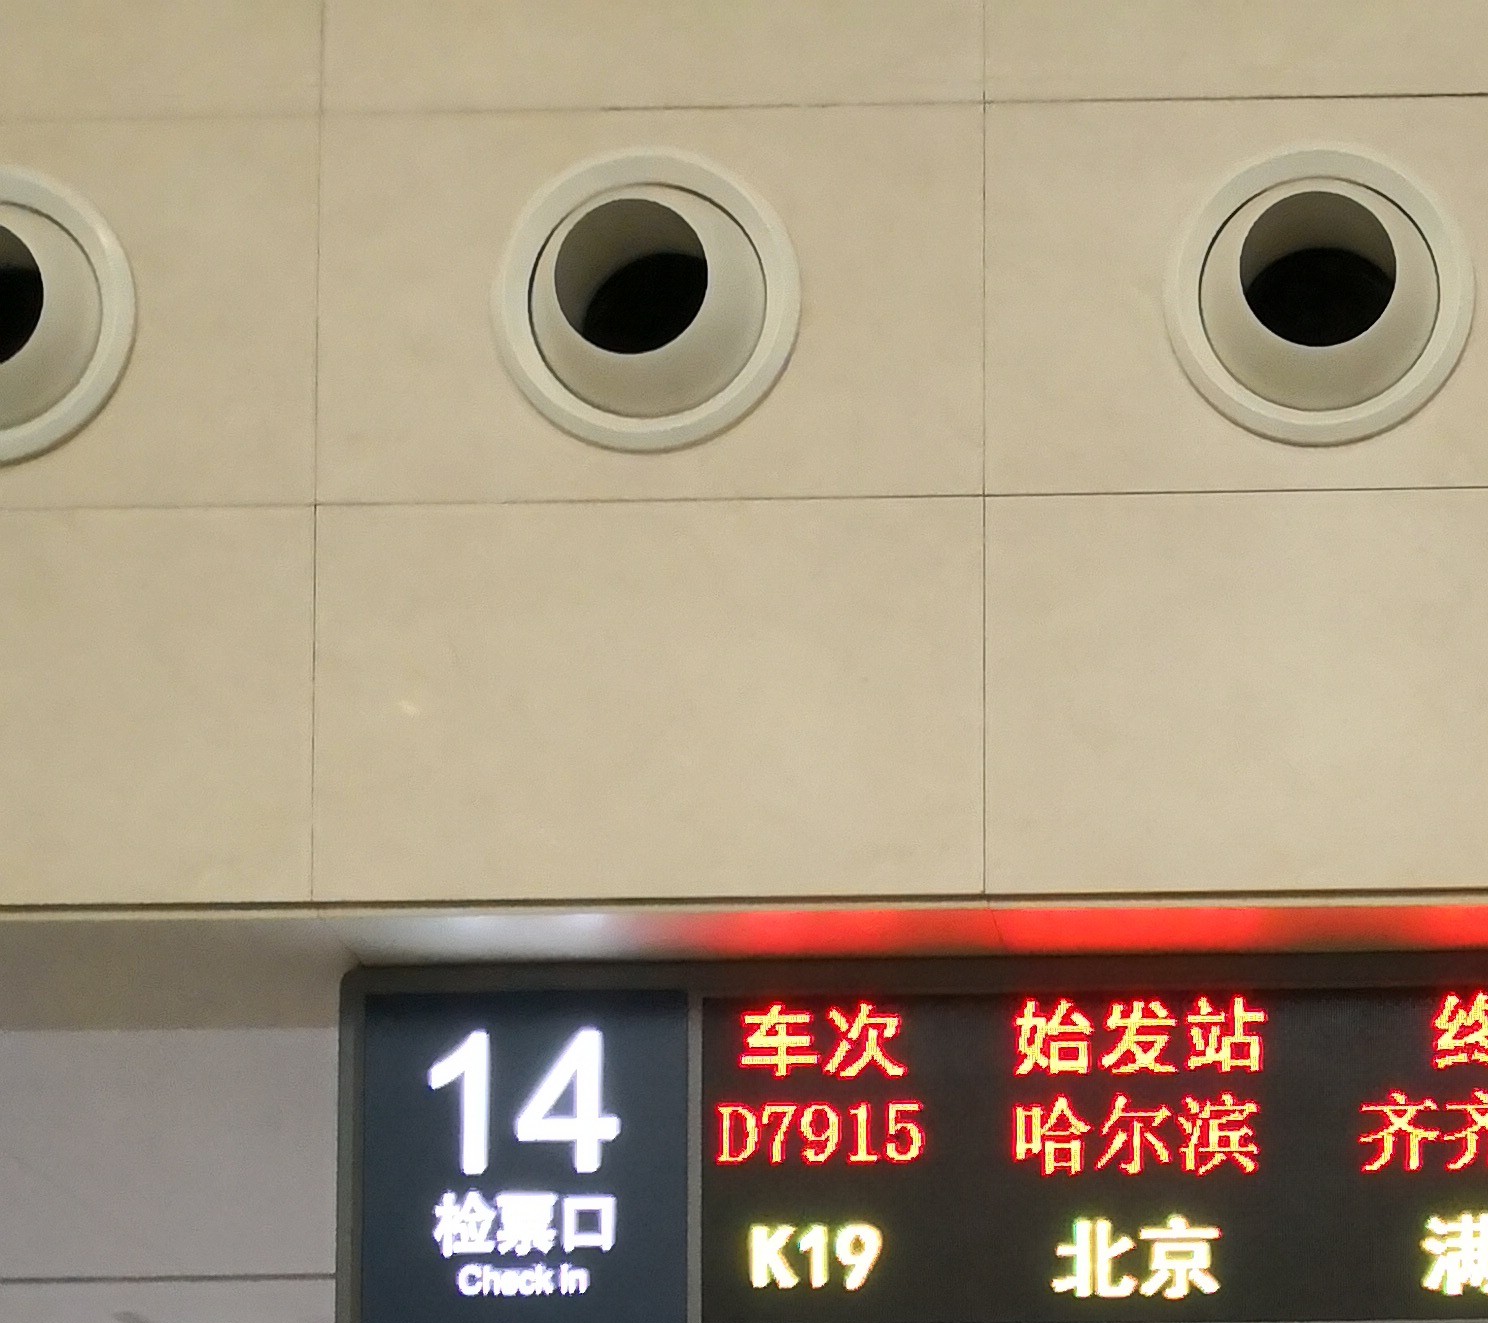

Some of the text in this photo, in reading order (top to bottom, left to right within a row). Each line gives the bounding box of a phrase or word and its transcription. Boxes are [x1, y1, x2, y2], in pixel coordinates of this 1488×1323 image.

[738, 1000, 908, 1080] 车次
[1011, 994, 1268, 1077] 始发站
[427, 1027, 621, 1175] 14
[715, 1099, 926, 1168] D7915
[1011, 1090, 1262, 1178] 哈尔滨
[432, 1190, 617, 1258] 检票口
[748, 1222, 884, 1291] K19
[1051, 1213, 1221, 1300] 北京
[456, 1262, 590, 1297] Check in
